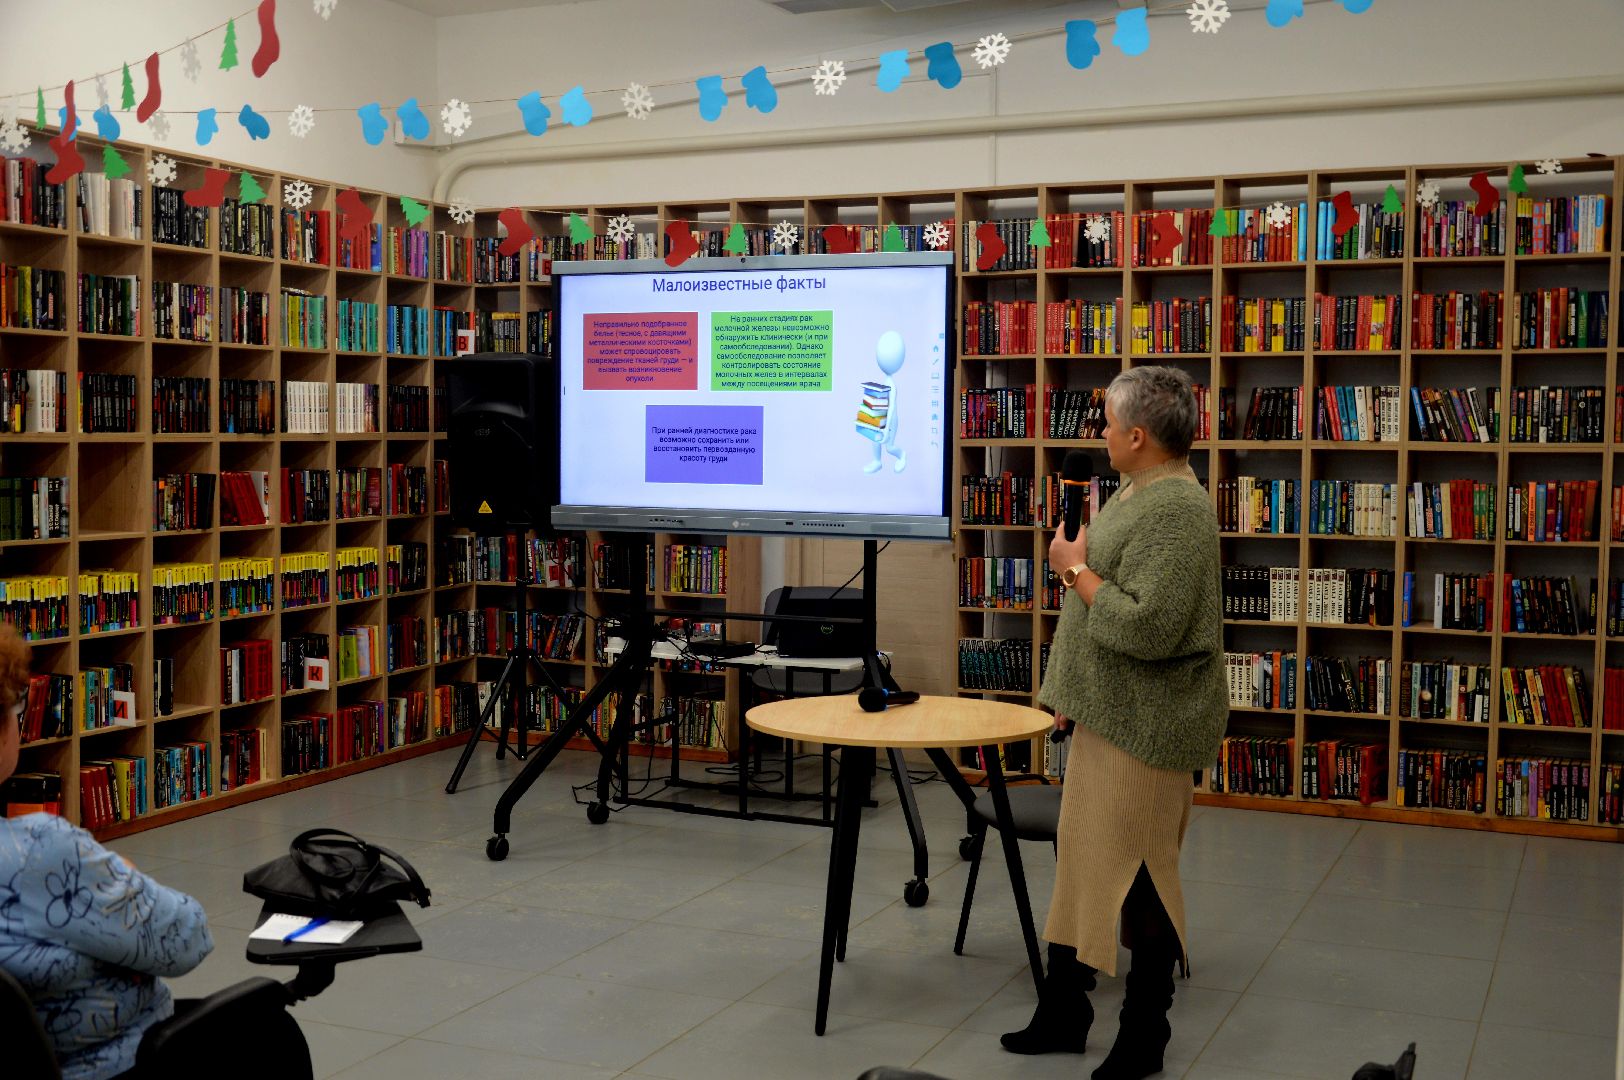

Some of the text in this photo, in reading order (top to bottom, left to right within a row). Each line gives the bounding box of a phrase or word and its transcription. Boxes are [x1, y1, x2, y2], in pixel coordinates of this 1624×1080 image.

[652, 275, 826, 293] Малоизвестные факты
[799, 315, 813, 324] рак
[593, 320, 687, 329] Неправильно подобранное
[648, 338, 691, 346] косточками)
[716, 334, 758, 342] обнаружить
[805, 333, 812, 342] (и
[720, 342, 794, 351] самообследовании).
[716, 352, 785, 360] самообследование
[626, 376, 654, 384] опухоли
[652, 426, 665, 435] При
[667, 426, 692, 436] ранней
[740, 428, 756, 436] рака
[703, 446, 755, 454] первозданную
[310, 666, 320, 680] К
[114, 700, 125, 718] И
